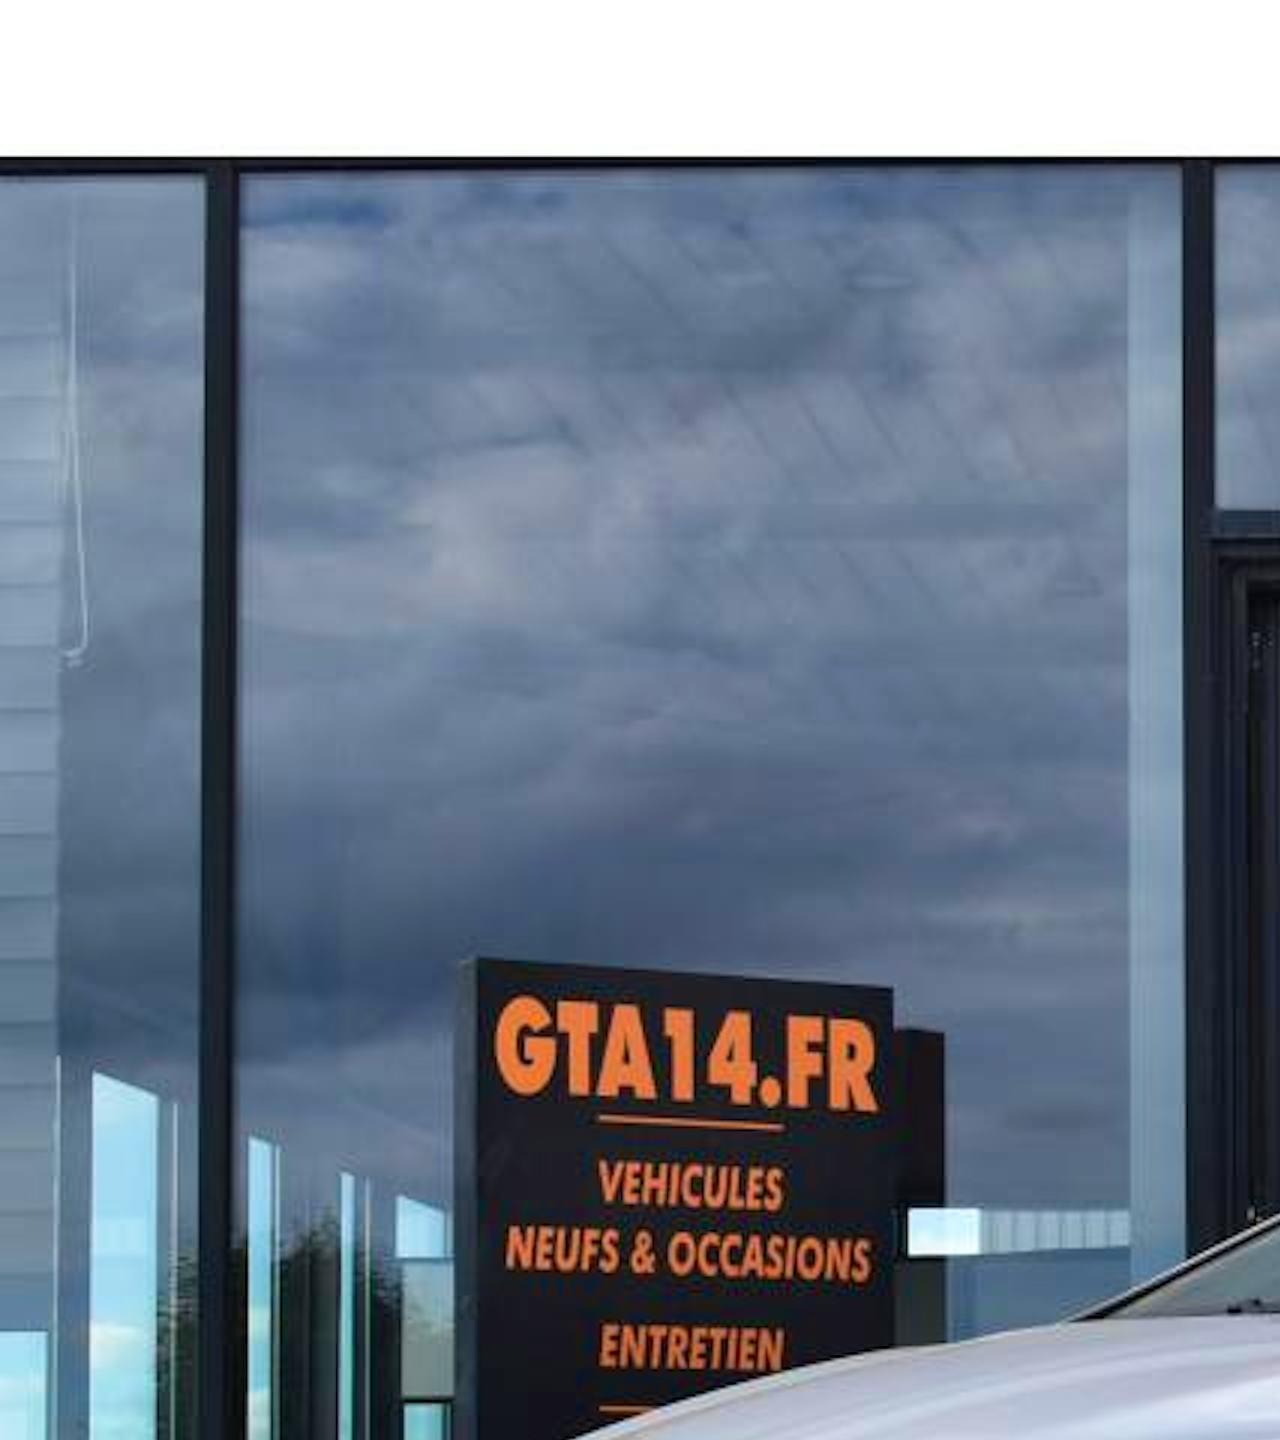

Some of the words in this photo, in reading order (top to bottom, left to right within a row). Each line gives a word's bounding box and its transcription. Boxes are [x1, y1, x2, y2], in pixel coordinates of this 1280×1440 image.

[494, 995, 880, 1113] GTA14.FR
[598, 1159, 784, 1212] VEHICULES
[505, 1225, 621, 1274] NEUFS
[630, 1230, 657, 1276] &
[667, 1231, 871, 1283] OCCASIONS
[599, 1324, 785, 1371] ENTRETIEN
